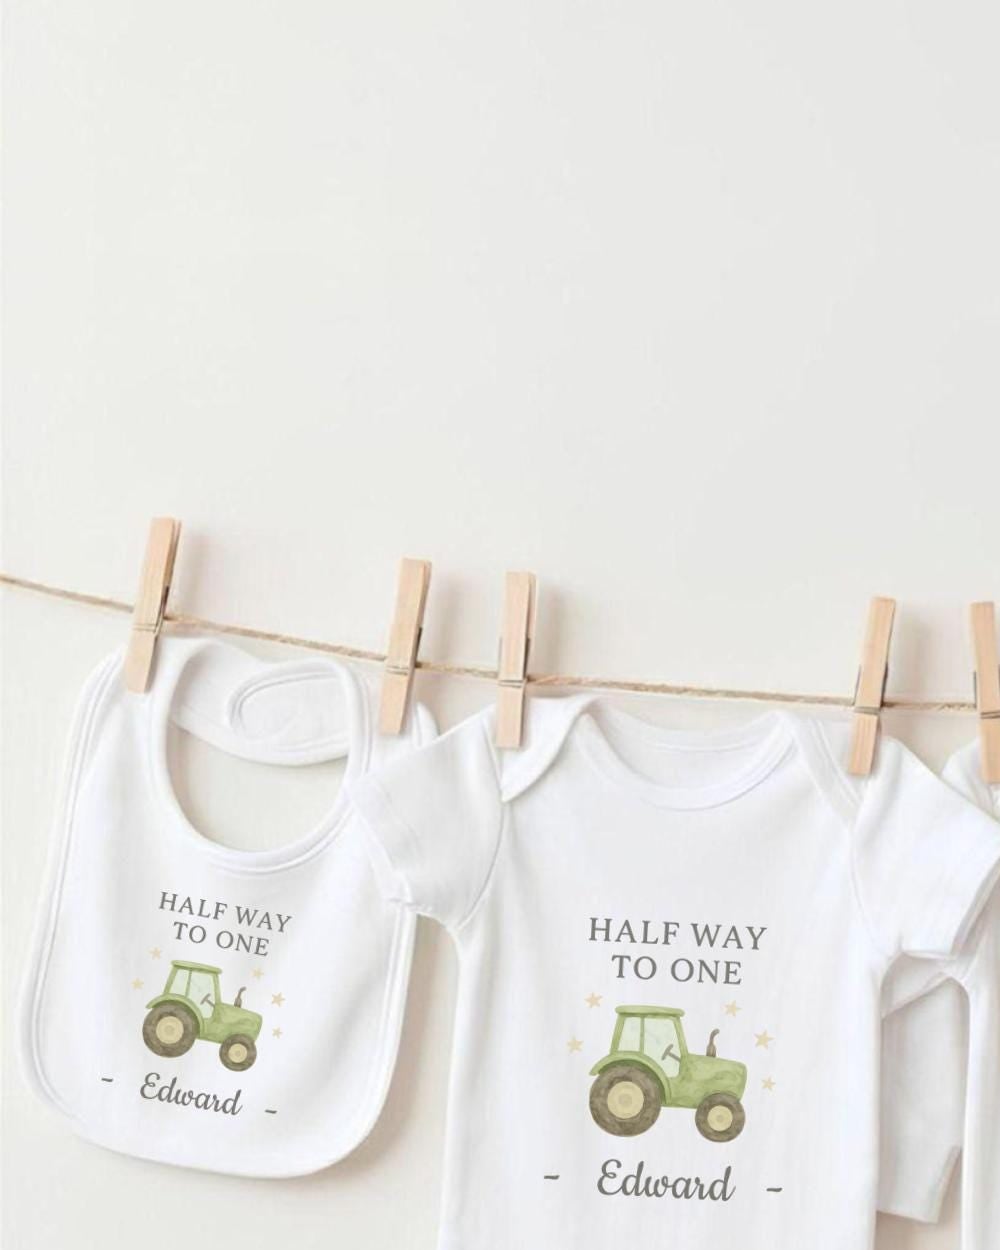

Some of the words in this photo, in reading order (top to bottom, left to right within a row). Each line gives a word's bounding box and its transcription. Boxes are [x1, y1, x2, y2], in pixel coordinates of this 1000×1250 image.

[159, 891, 228, 920] HALF
[235, 906, 291, 933] WAY
[173, 921, 207, 944] TO
[216, 930, 270, 956] ONE
[588, 917, 680, 945] HALF
[690, 923, 768, 950] WAY
[611, 954, 657, 980] TO
[670, 958, 742, 984] ONE
[140, 1072, 243, 1115] Edward
[597, 1159, 736, 1201] Edward
